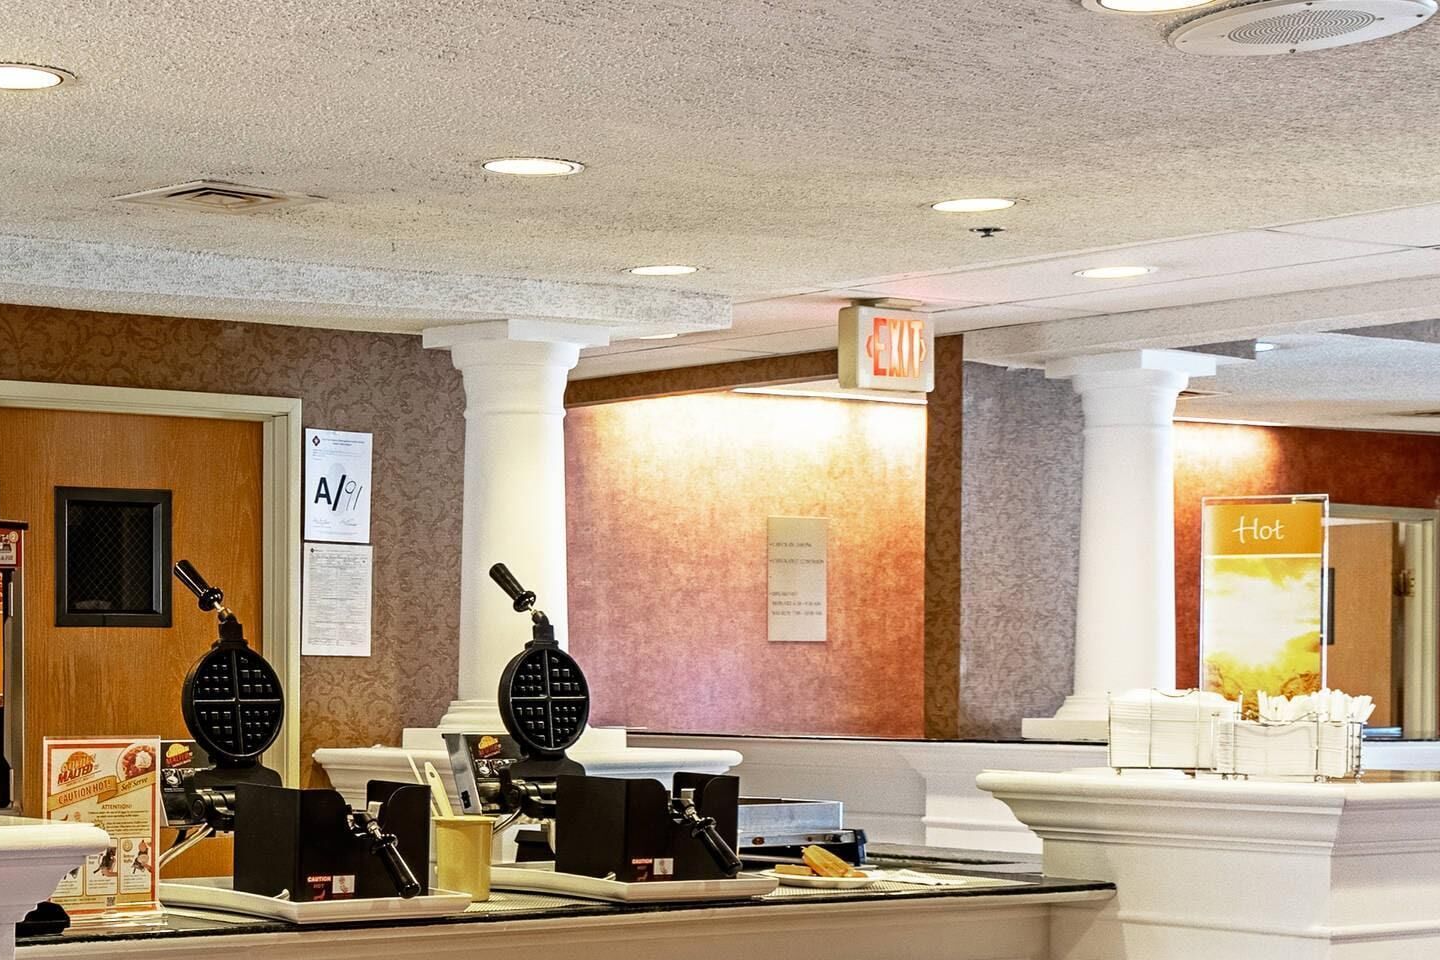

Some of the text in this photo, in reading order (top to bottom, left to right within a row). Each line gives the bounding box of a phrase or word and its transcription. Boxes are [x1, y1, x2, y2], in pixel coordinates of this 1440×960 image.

[873, 317, 926, 378] EXIT
[1231, 515, 1286, 545] Hot
[58, 785, 92, 804] CAUTION
[93, 780, 111, 794] HOT!
[120, 777, 149, 792] Self Serve
